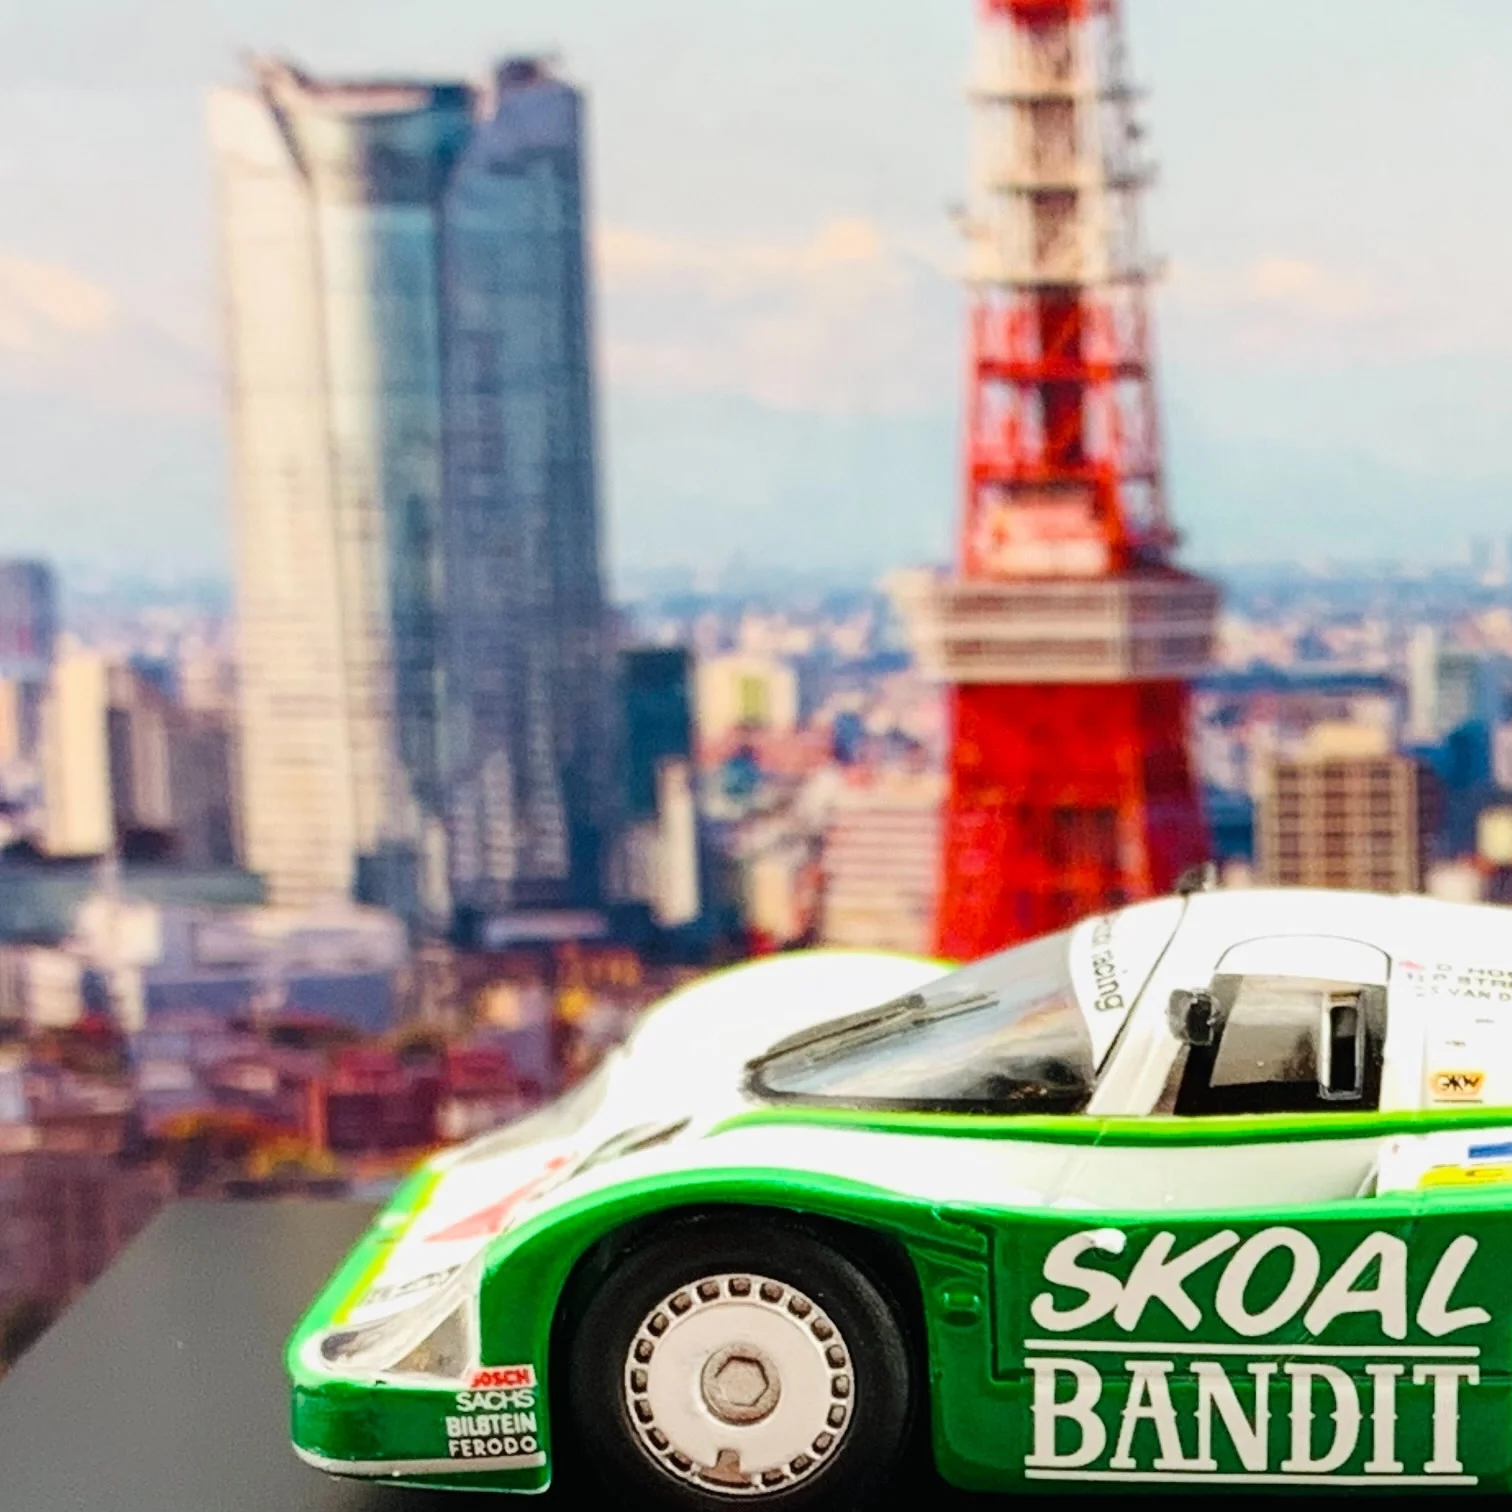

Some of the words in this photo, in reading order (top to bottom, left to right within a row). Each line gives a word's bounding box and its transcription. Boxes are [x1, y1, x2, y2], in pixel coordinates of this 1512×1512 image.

[1029, 1226, 1492, 1341] SKOAL
[455, 1388, 536, 1413] SACHS
[445, 1410, 538, 1438] BILSTEIN
[1024, 1357, 1480, 1476] BANDIT
[448, 1435, 538, 1457] FERODO
